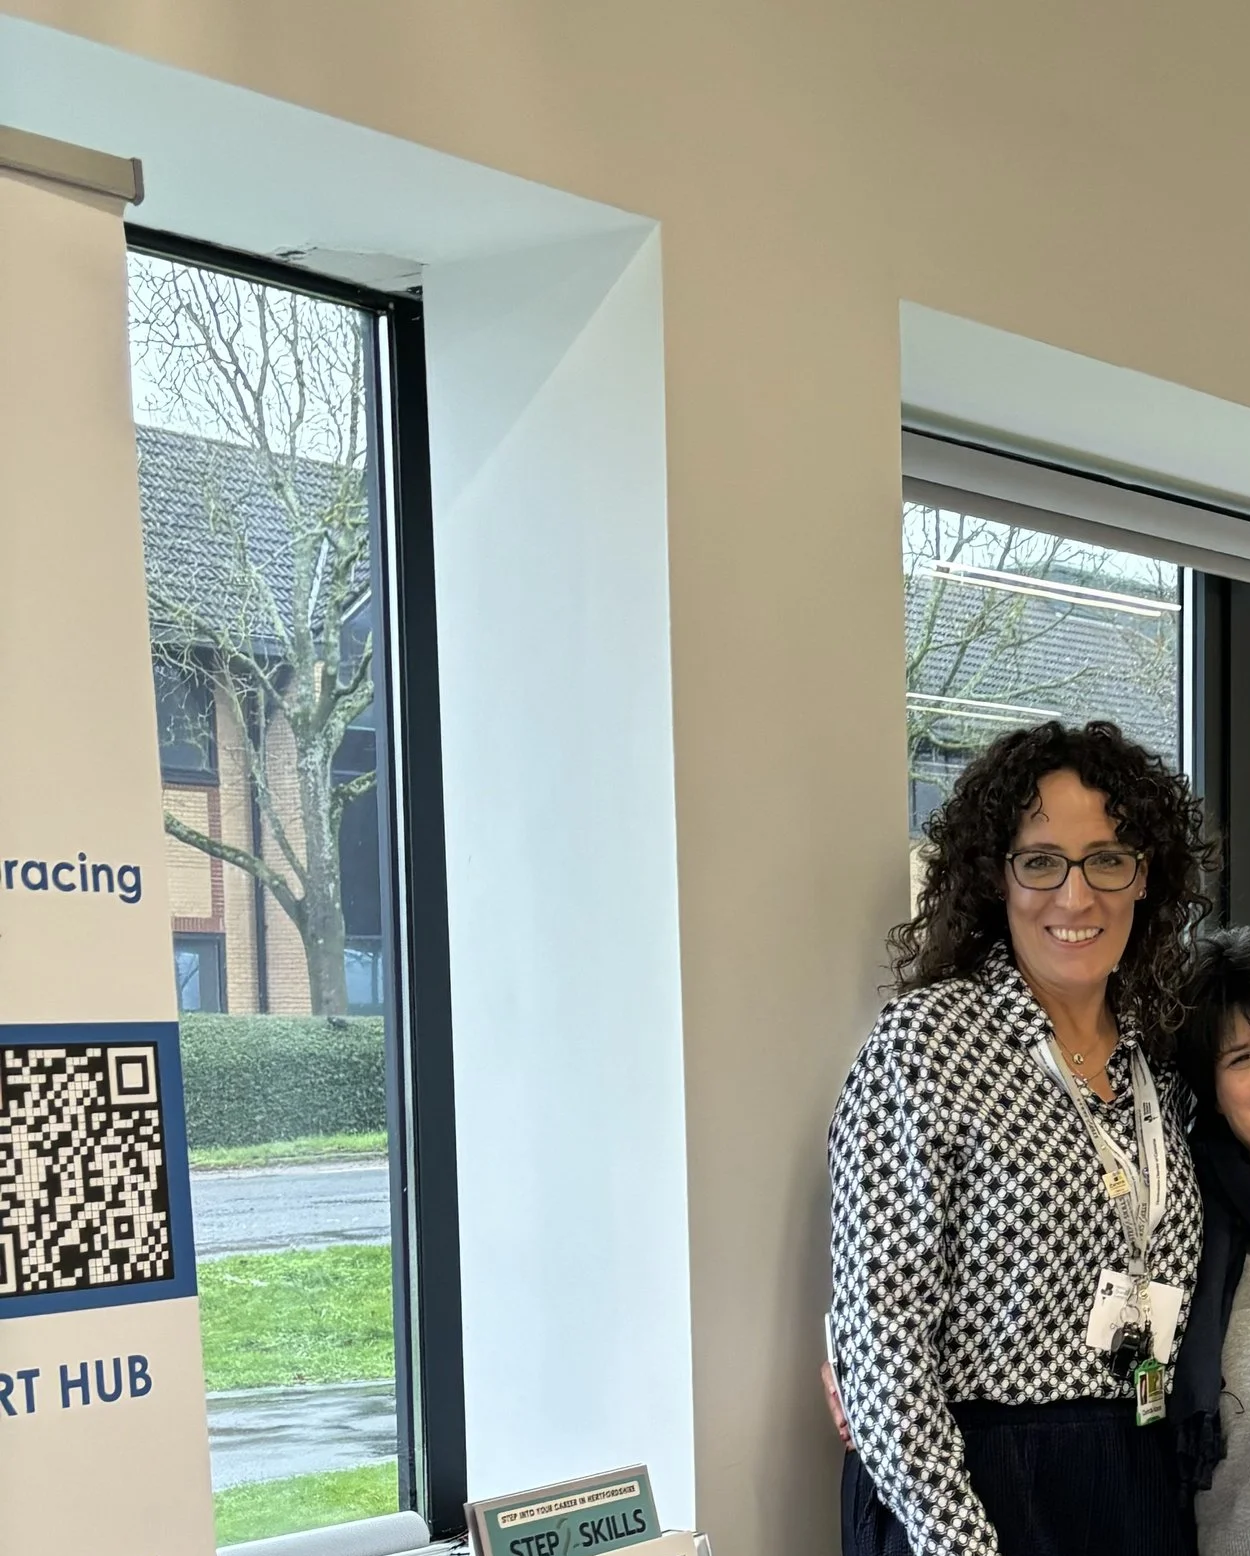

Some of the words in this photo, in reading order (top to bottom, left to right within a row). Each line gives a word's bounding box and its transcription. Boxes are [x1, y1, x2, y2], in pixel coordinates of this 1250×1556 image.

[0, 852, 141, 902] racing
[59, 1355, 152, 1409] HUB
[501, 1513, 517, 1523] STEP
[519, 1509, 534, 1519] INTO
[536, 1505, 552, 1515] YOUR
